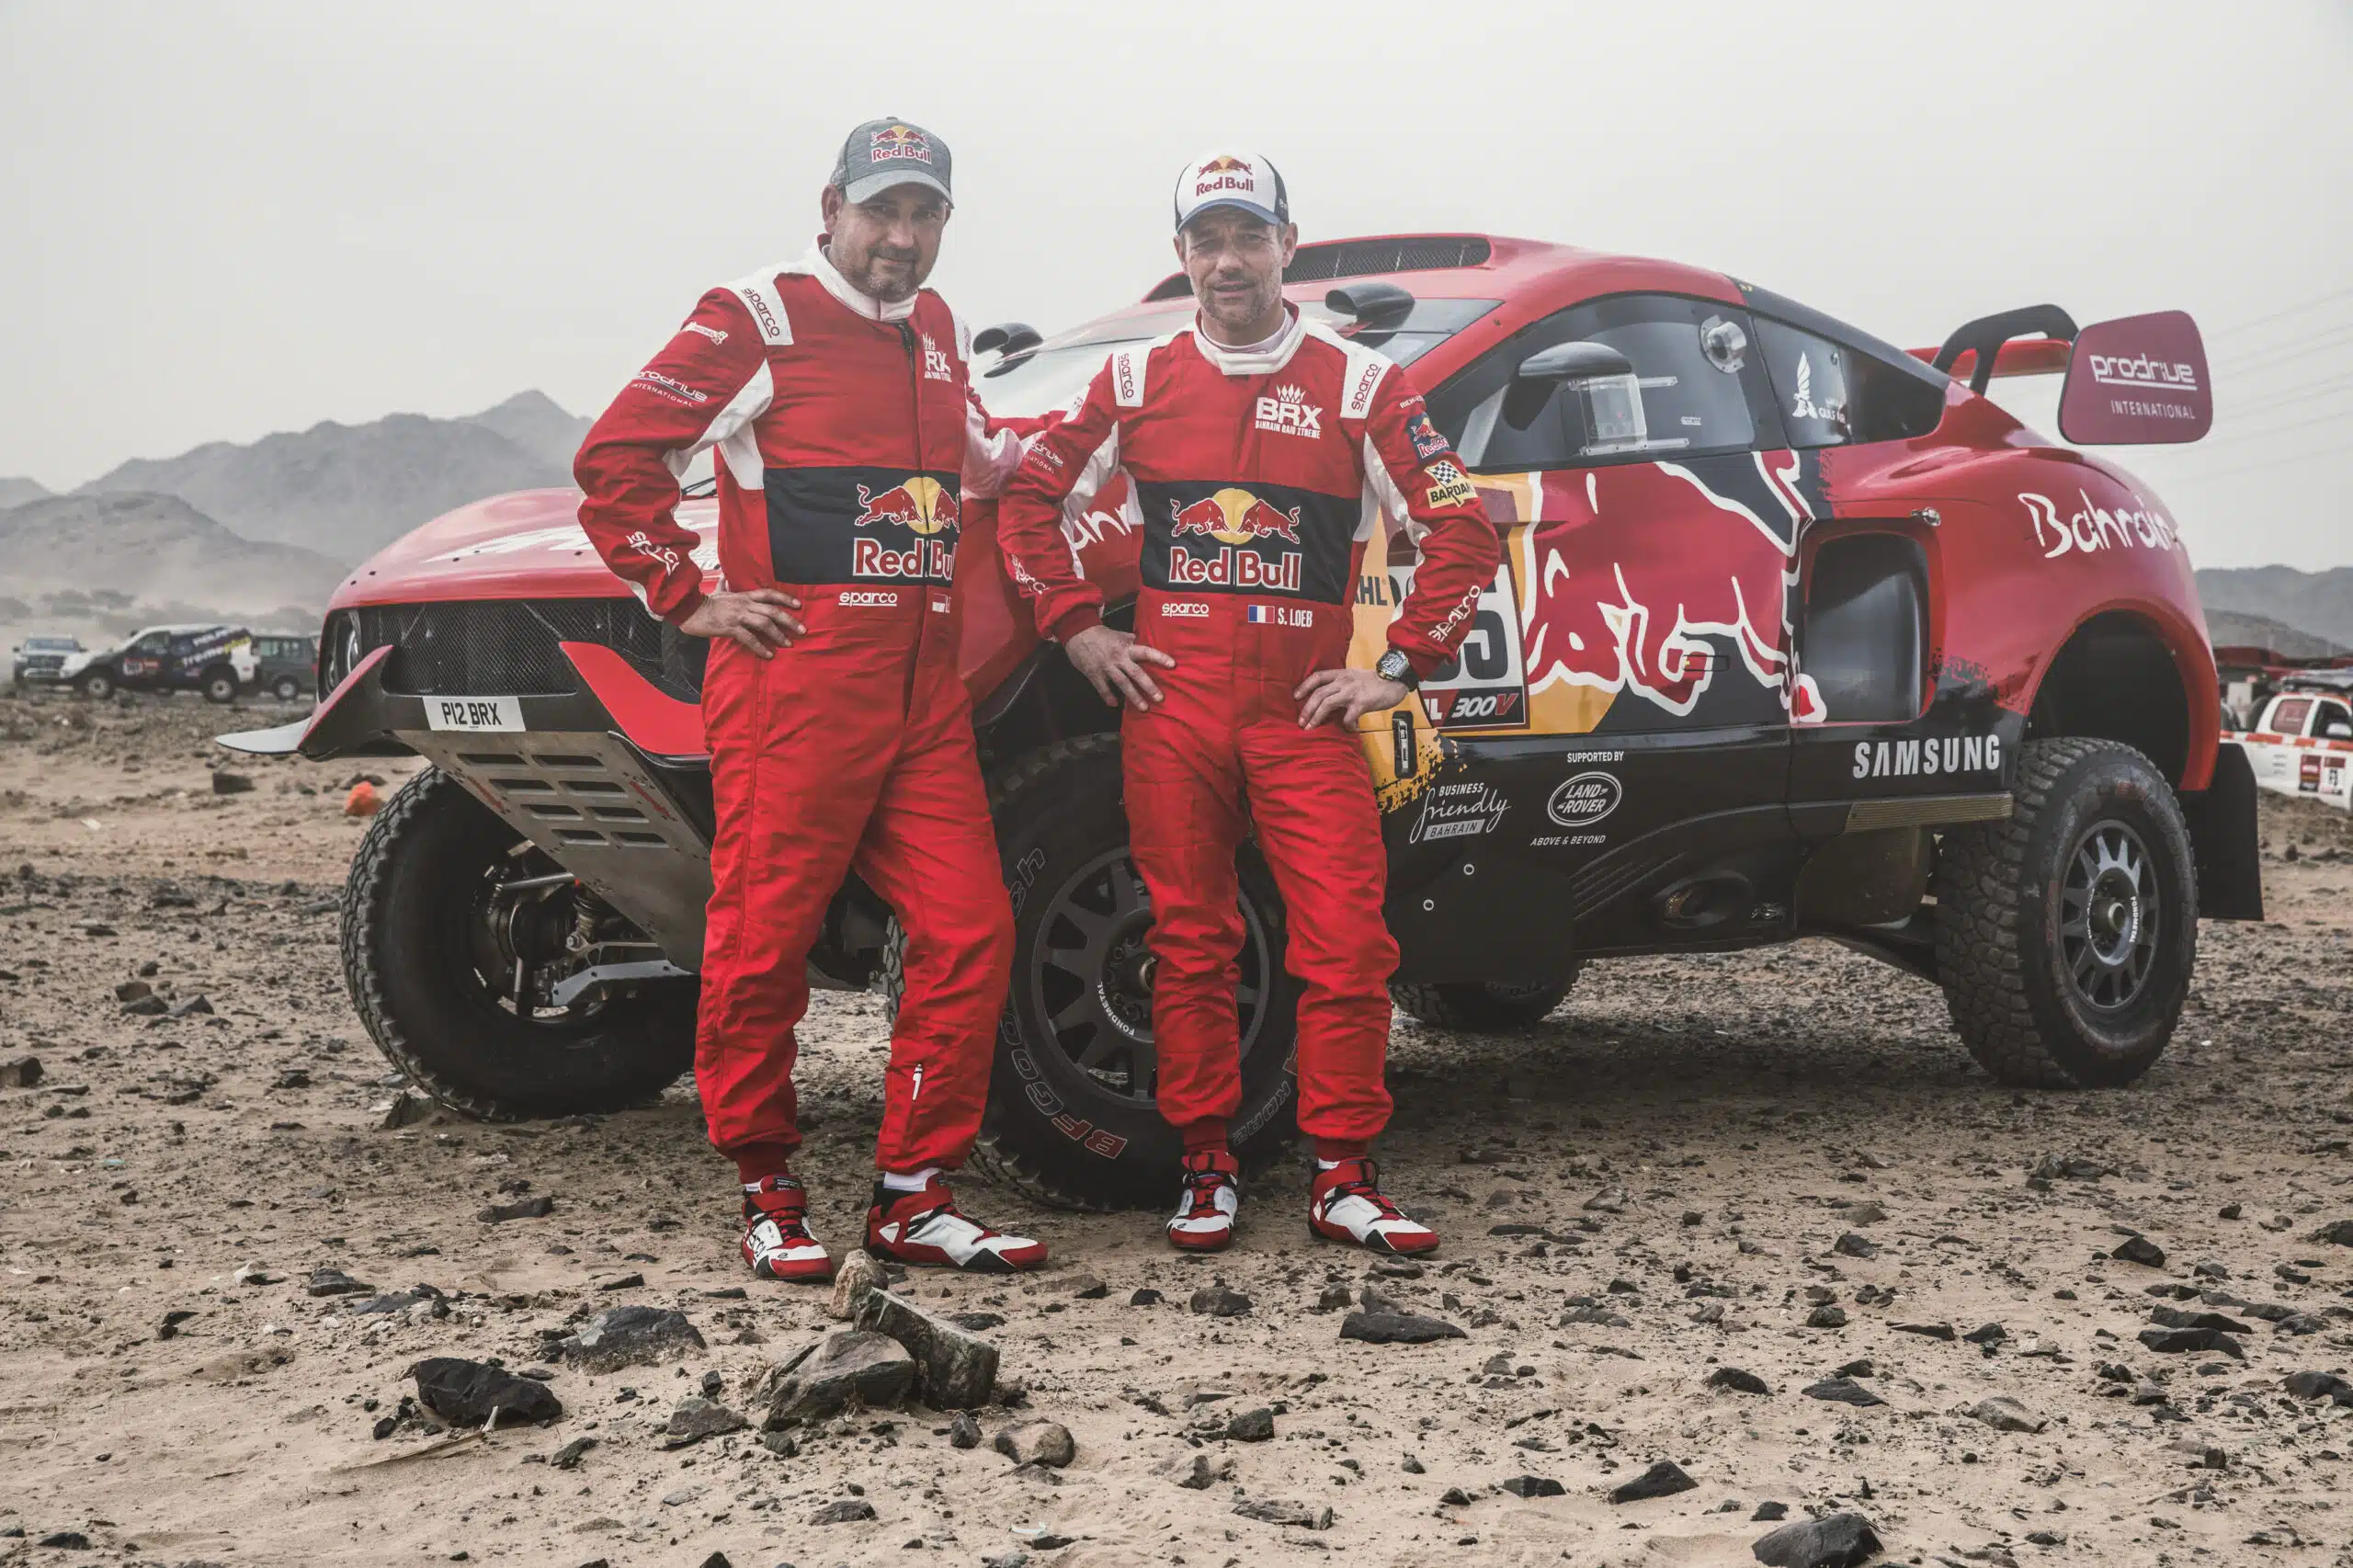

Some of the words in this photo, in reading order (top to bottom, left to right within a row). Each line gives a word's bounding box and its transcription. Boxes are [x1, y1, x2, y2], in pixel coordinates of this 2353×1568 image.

[871, 143, 902, 163] Red
[904, 144, 932, 165] Bull
[1196, 176, 1223, 197] Red
[1225, 177, 1254, 192] Bull
[742, 287, 780, 338] sparco
[925, 350, 952, 373] RX
[1118, 353, 1135, 400] sparco
[1351, 363, 1382, 412] sparco
[1256, 397, 1324, 429] BRX
[2111, 400, 2196, 420] INTERNATIONAL
[853, 537, 924, 578] Red
[1168, 546, 1233, 585] Red
[1236, 550, 1302, 592] Bull
[838, 591, 898, 607] sparco
[1162, 602, 1210, 617] sparco
[1278, 607, 1288, 626] S.
[1290, 610, 1313, 629] LOEB
[441, 702, 468, 725] P12
[468, 702, 503, 726] BRX
[1451, 693, 1519, 719] 300V
[1567, 752, 1613, 763] SUPPORTED
[1614, 751, 1625, 762] BY
[1853, 734, 2000, 779] SAMSUNG
[1438, 782, 1485, 798] BUSINESS
[1565, 784, 1602, 800] LAND
[1409, 787, 1513, 845] friendly
[1563, 798, 1608, 814] ROVER
[1430, 821, 1479, 838] BAHRAIN
[1530, 836, 1560, 846] ABOVE
[1562, 835, 1570, 846] &
[1570, 835, 1607, 845] BEYOND
[1097, 982, 1135, 1037] FONDMETAL
